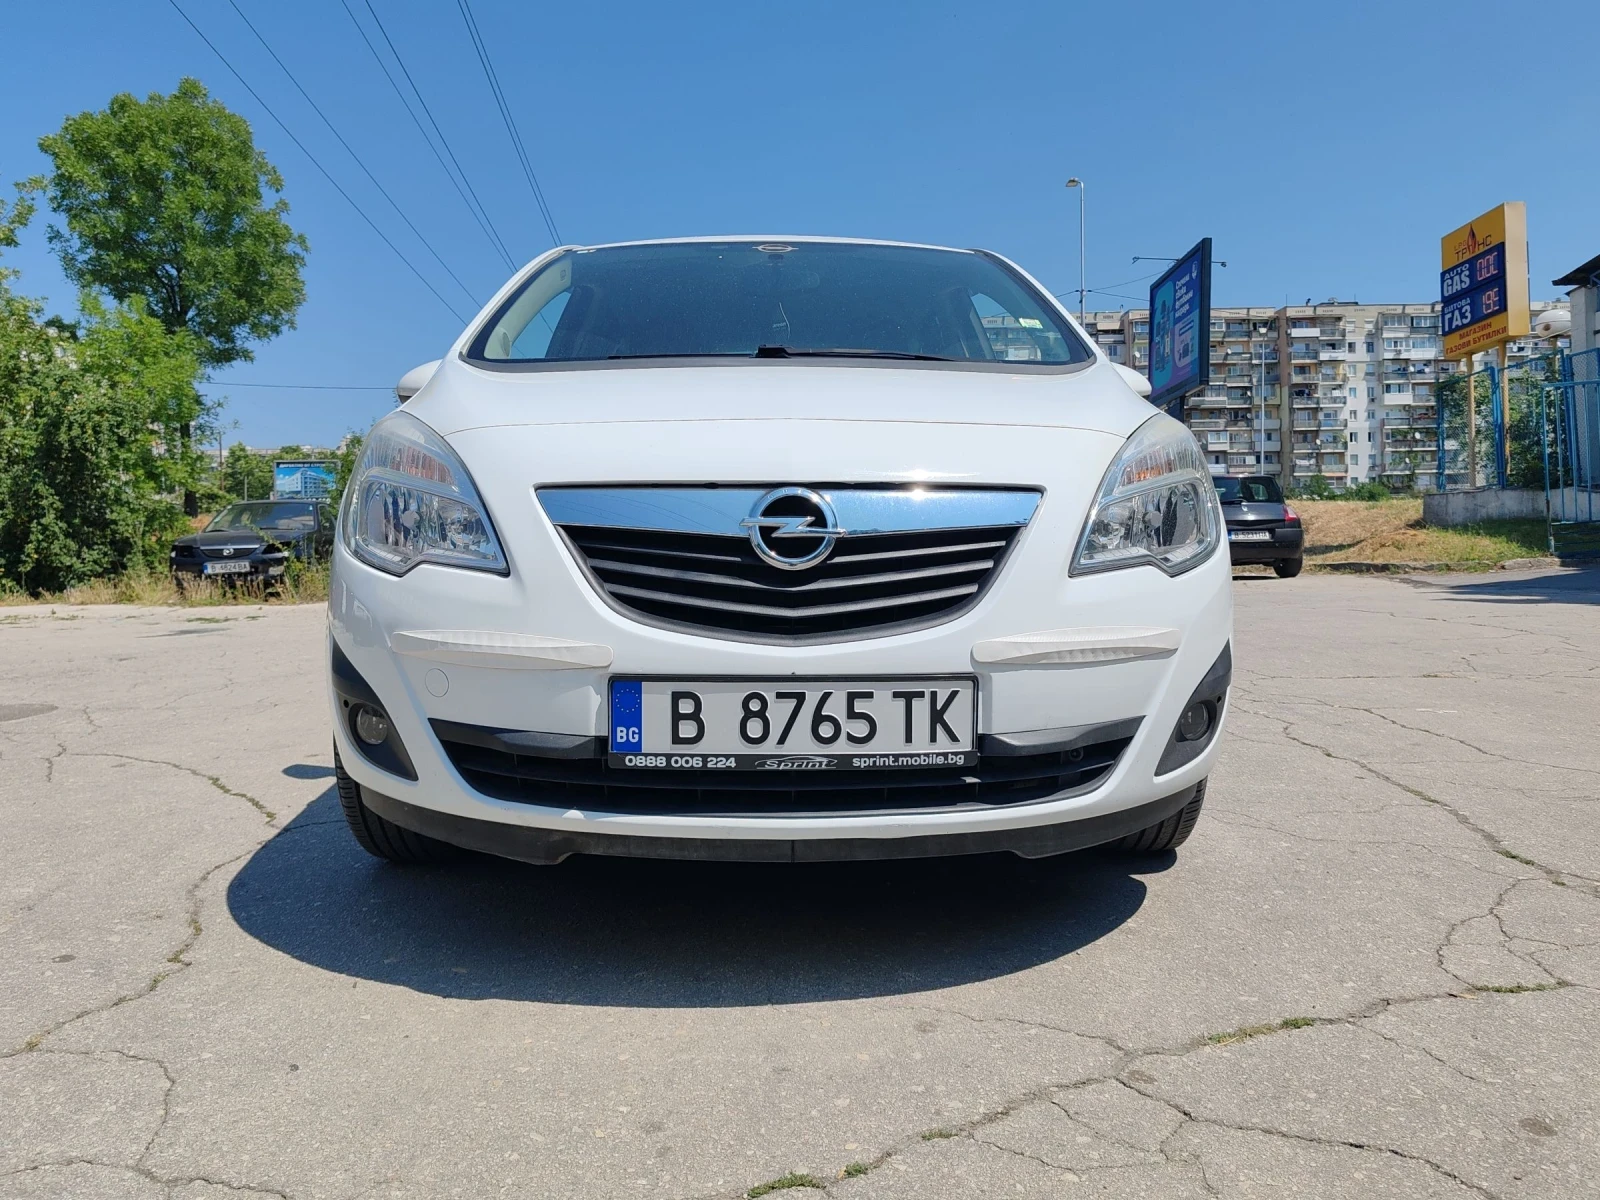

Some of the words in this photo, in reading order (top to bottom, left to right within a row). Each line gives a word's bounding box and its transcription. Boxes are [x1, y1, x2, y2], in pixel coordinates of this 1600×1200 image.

[1444, 263, 1469, 280] AUTO
[1443, 270, 1470, 297] GAS
[1444, 305, 1471, 331] ГАЗ
[1459, 322, 1492, 340] МАГАЗИН
[1446, 339, 1471, 355] ГАЗОВИ
[1472, 326, 1507, 345] БУТИЛКИ
[671, 691, 705, 745] B
[740, 690, 877, 745] 8765
[892, 690, 960, 743] TK
[616, 727, 639, 742] BG
[625, 755, 666, 767] 0888
[671, 757, 703, 767] 006
[707, 757, 736, 768] 224
[765, 760, 829, 770] Sprint
[852, 754, 965, 767] sprint.mobile.bg
